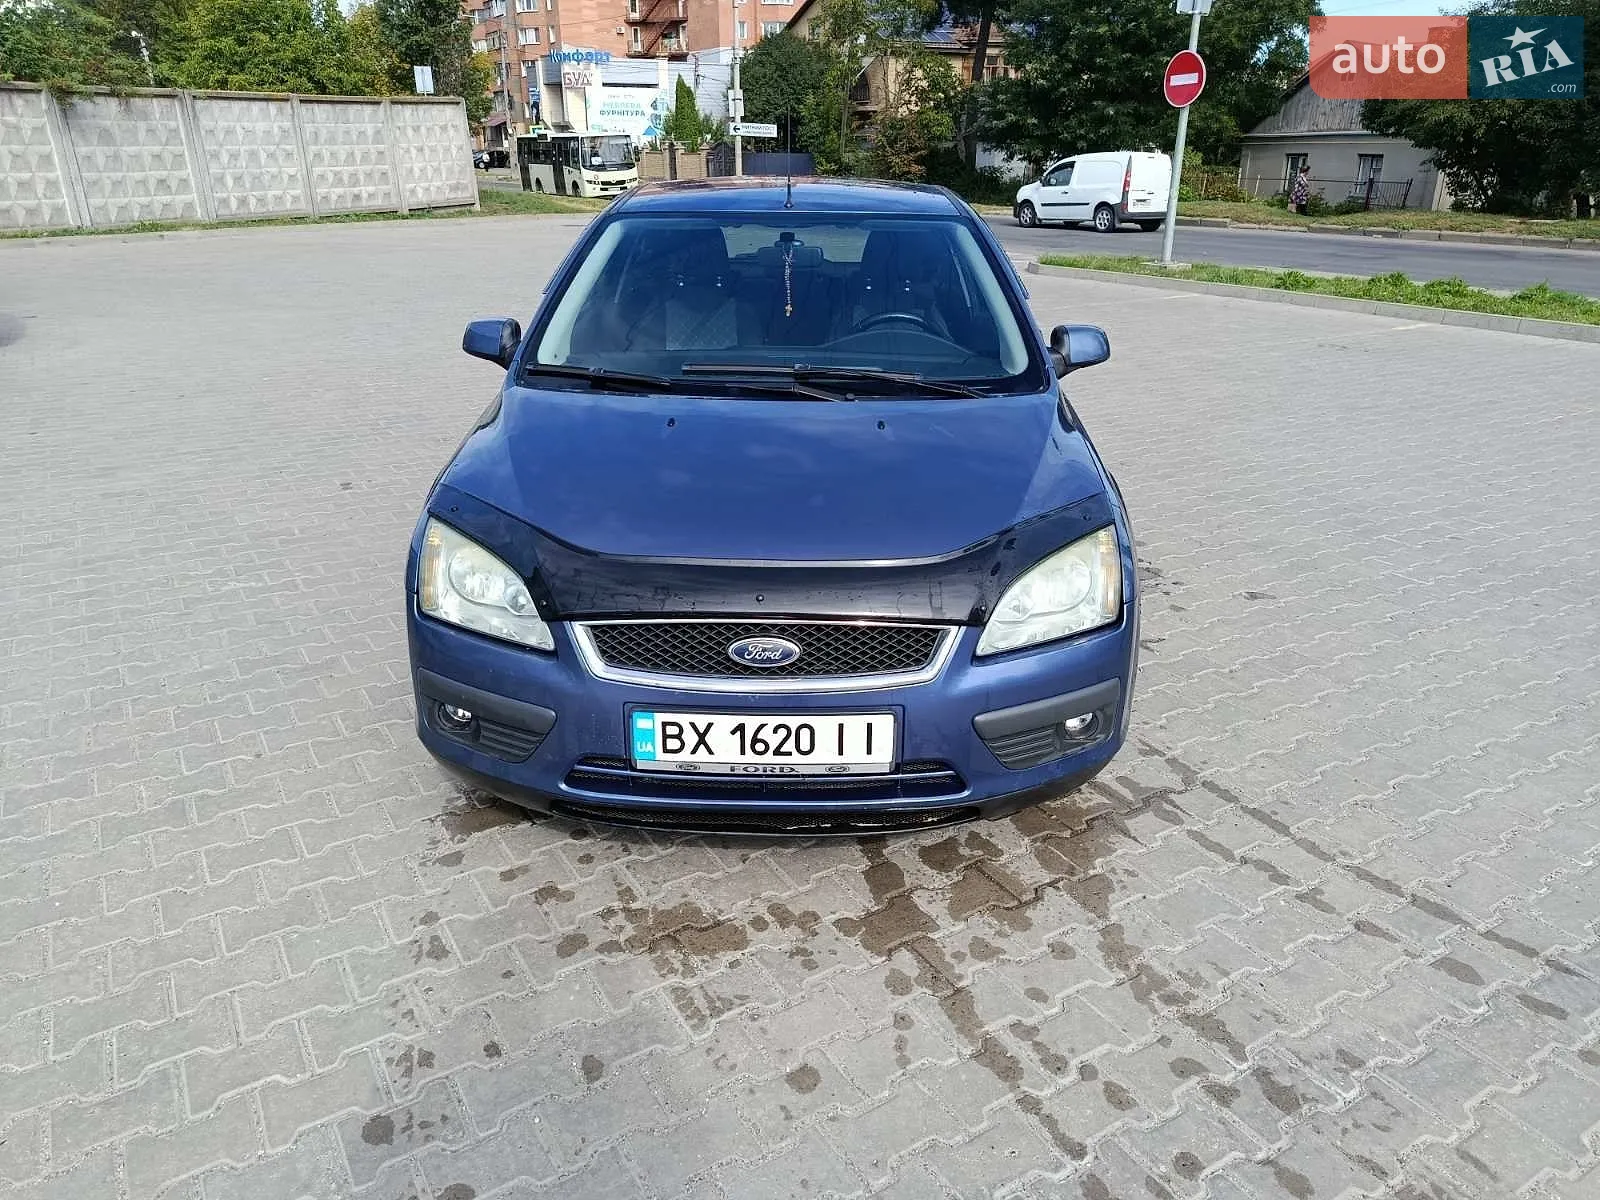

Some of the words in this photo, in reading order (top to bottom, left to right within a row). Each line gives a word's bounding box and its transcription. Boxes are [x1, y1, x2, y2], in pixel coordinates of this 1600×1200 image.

[745, 644, 783, 660] Ford
[661, 721, 715, 756] BX
[730, 722, 816, 757] 1620
[638, 742, 656, 753] UA
[730, 765, 797, 774] FORD
